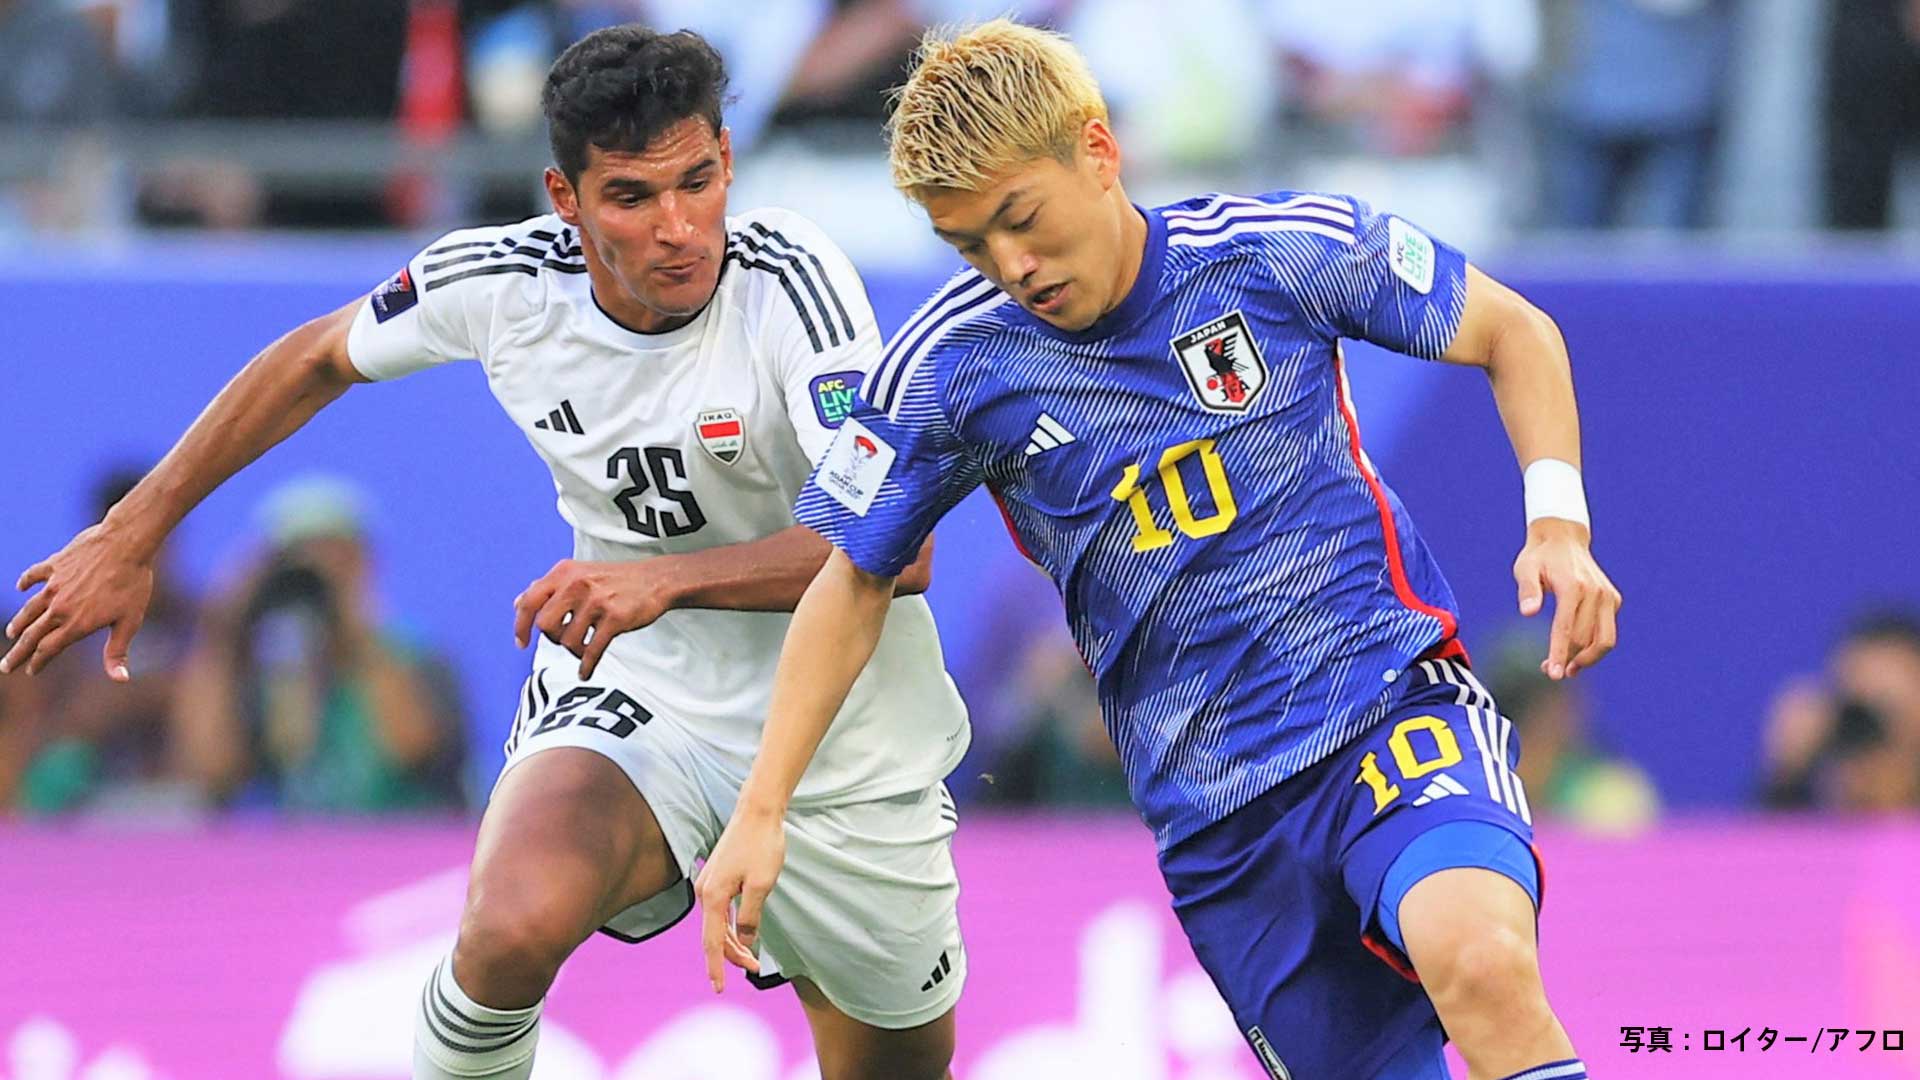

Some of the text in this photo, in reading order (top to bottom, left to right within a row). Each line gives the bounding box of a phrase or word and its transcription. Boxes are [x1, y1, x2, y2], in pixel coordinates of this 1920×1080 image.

[1396, 241, 1405, 267] AFC
[1403, 232, 1416, 274] LIVE
[1190, 320, 1226, 343] JAPAN
[818, 379, 845, 393] AFC
[820, 387, 858, 408] LIV
[704, 412, 732, 422] IRAQ
[607, 447, 708, 538] 25
[1110, 439, 1238, 553] 10
[530, 687, 654, 739] 25
[1354, 715, 1463, 816] 10
